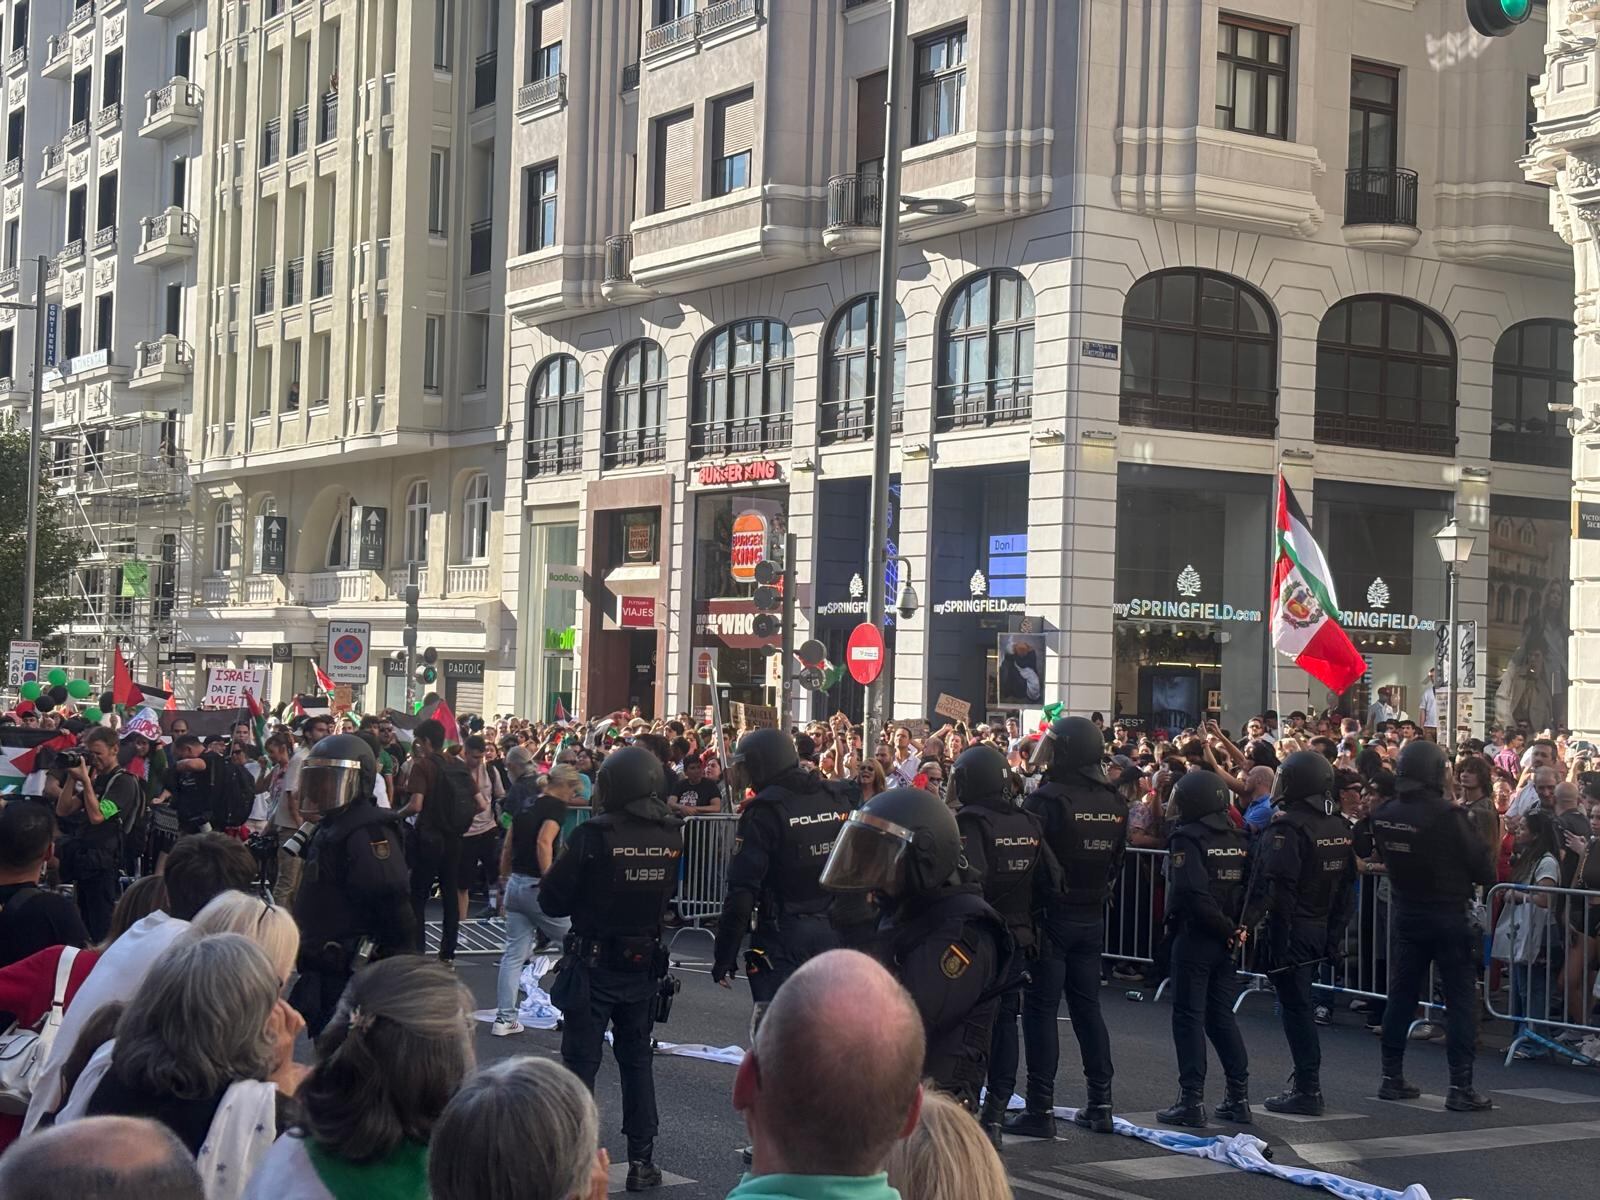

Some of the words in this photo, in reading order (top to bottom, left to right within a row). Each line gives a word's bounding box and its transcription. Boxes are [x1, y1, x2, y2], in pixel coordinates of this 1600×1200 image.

[48, 304, 56, 367] CONTINENTAL
[698, 464, 743, 485] BURGER
[744, 461, 777, 481] KING
[630, 538, 649, 550] KING
[732, 534, 763, 547] BURGER
[994, 540, 1010, 551] Don
[732, 547, 763, 566] KING
[622, 607, 655, 617] VIAJES
[1112, 598, 1262, 622] mySPRINGFIELD.com
[695, 625, 705, 635] OF
[215, 669, 260, 683] ISRAEL
[211, 684, 237, 694] DATE
[210, 695, 248, 706] VUELT
[943, 697, 967, 710] STOP
[789, 811, 841, 827] POLICIA
[1075, 812, 1118, 822] POLICIA
[995, 836, 1034, 846] POLICIA
[1316, 837, 1347, 847] POLICIA
[613, 847, 672, 857] POLICIA
[1207, 848, 1243, 857] POLICIA
[624, 868, 666, 881] 1U992
